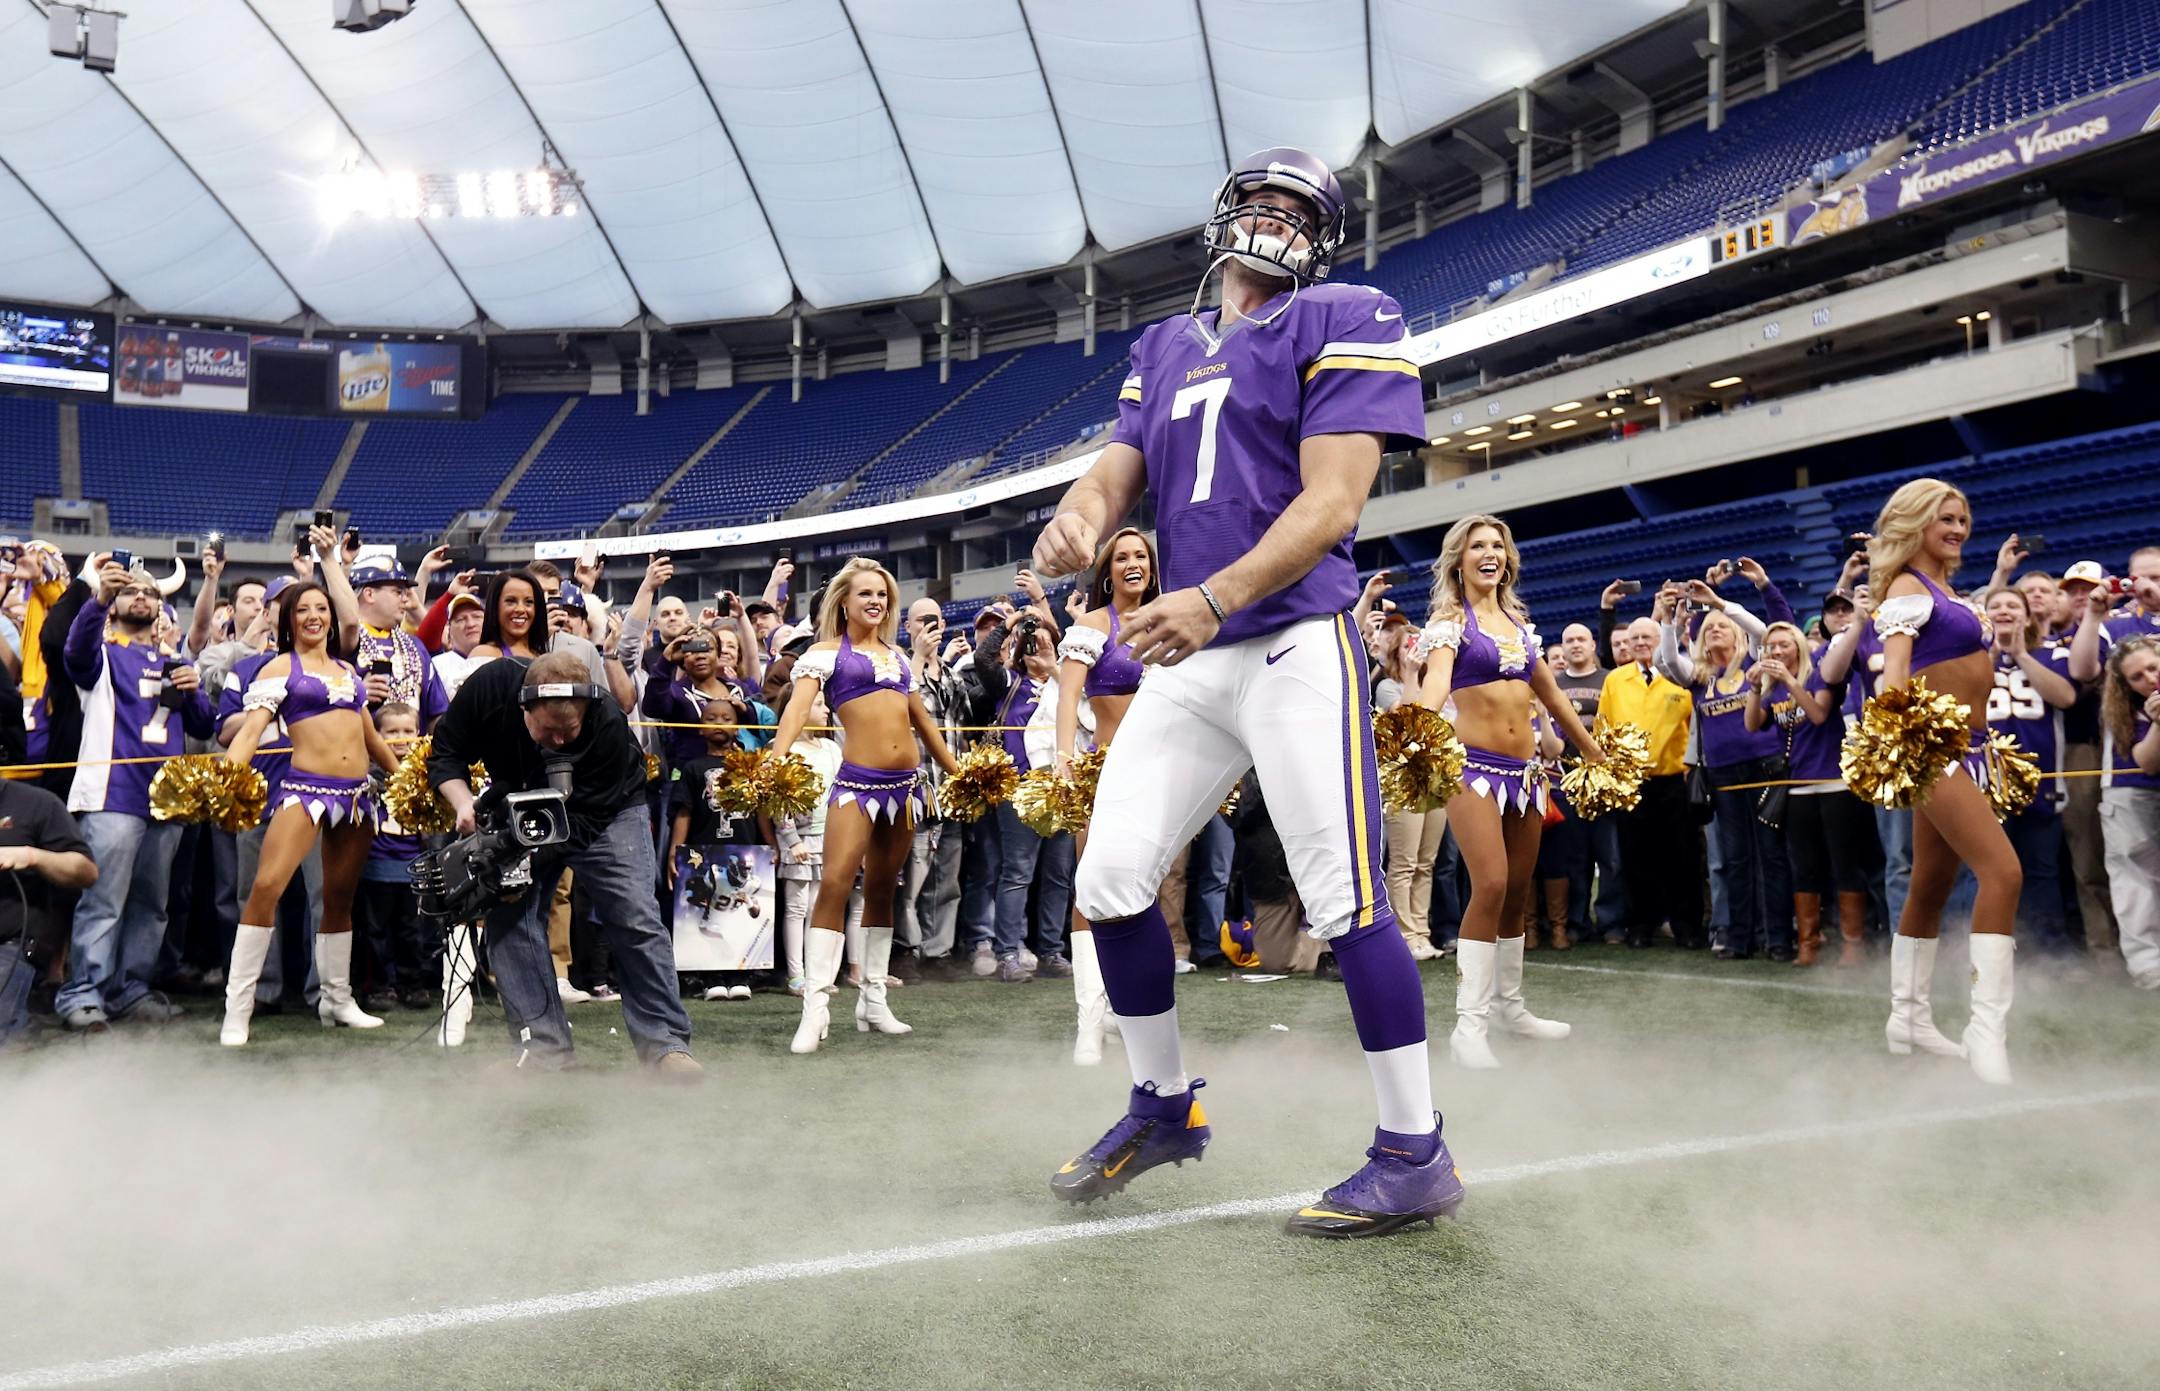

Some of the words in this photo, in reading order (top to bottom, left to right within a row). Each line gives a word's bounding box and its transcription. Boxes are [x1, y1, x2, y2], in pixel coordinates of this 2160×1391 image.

[184, 346, 246, 366] SKOL
[186, 364, 247, 378] VIKINGS!
[430, 380, 455, 396] TIME
[1170, 377, 1233, 504] 7
